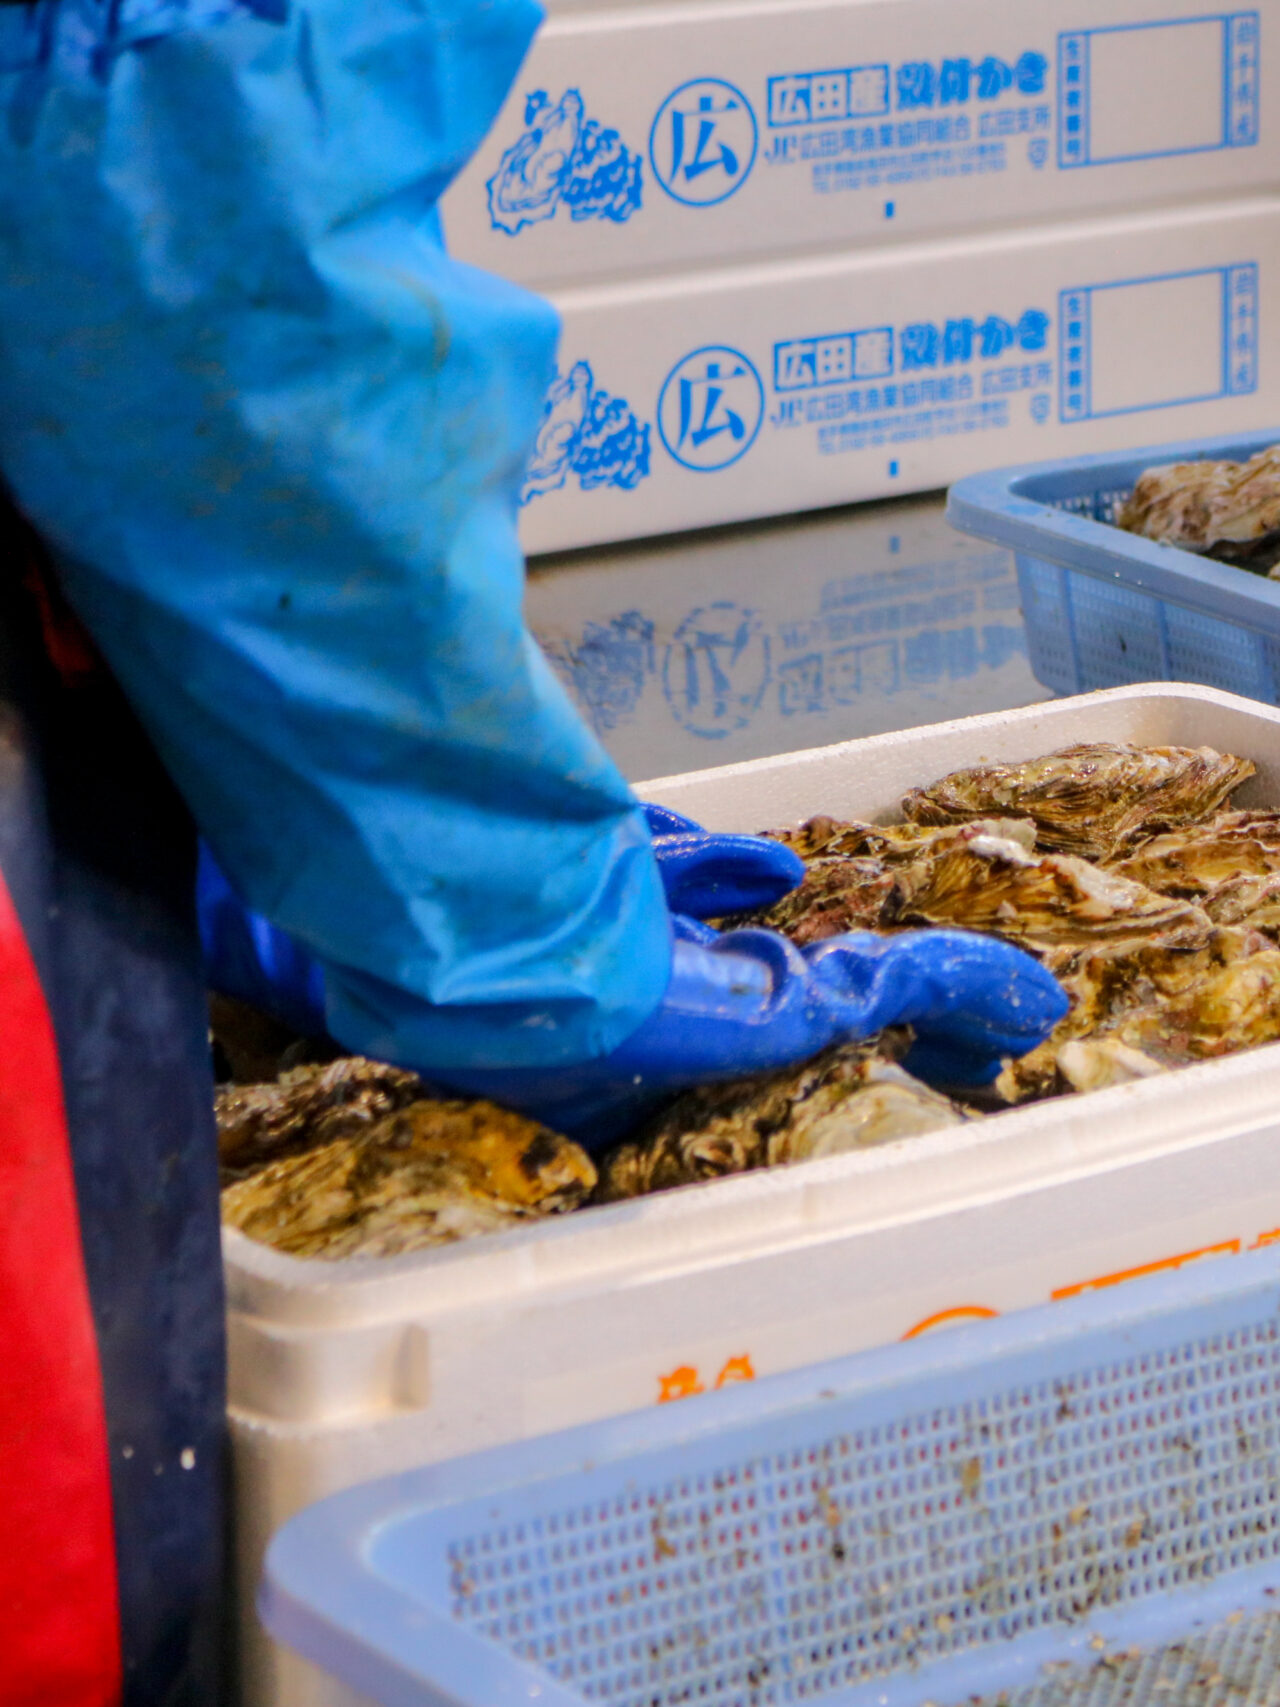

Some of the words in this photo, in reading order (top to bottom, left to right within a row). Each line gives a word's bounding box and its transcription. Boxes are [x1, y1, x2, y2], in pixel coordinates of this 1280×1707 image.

[896, 50, 1048, 112] 殻付かき
[900, 308, 1050, 371] 殻付かき
